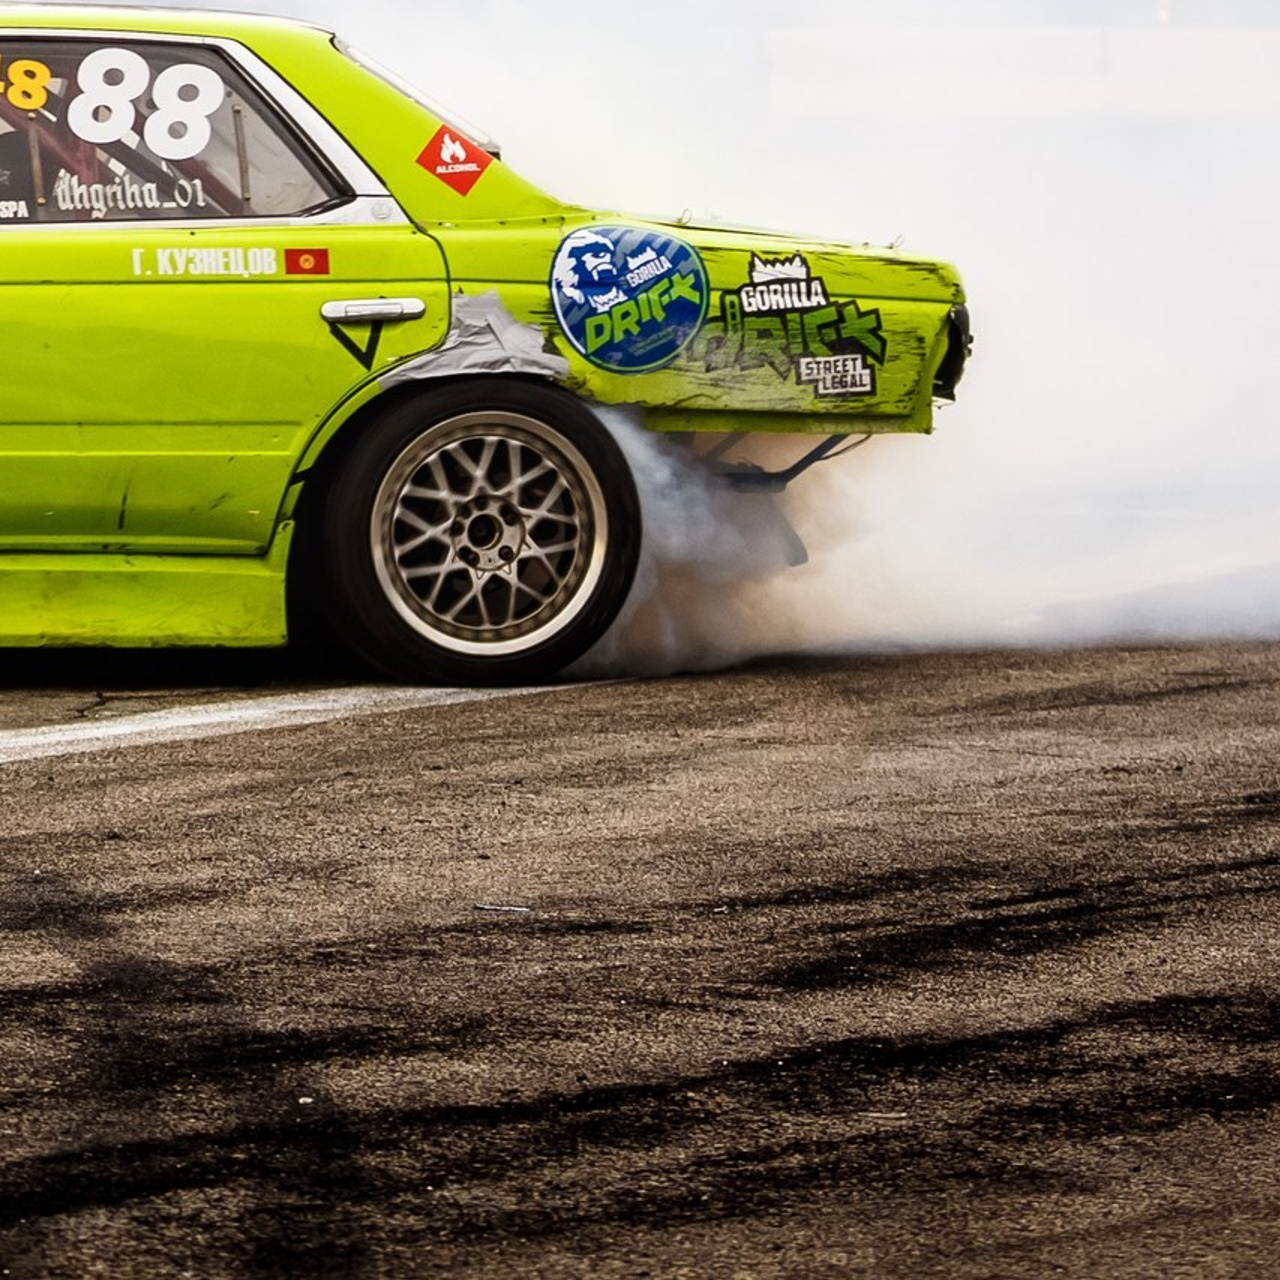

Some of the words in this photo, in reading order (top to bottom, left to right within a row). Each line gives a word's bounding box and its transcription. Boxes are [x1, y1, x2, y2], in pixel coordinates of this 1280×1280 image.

[67, 47, 225, 161] 88
[435, 162, 482, 175] ALCOHOL
[132, 248, 152, 276] Г.
[156, 248, 277, 278] КУЗНЕЦОВ
[625, 255, 673, 288] GORILLA
[739, 279, 828, 314] GORILLA
[804, 356, 859, 377] STREET
[822, 374, 868, 391] LEGAL
